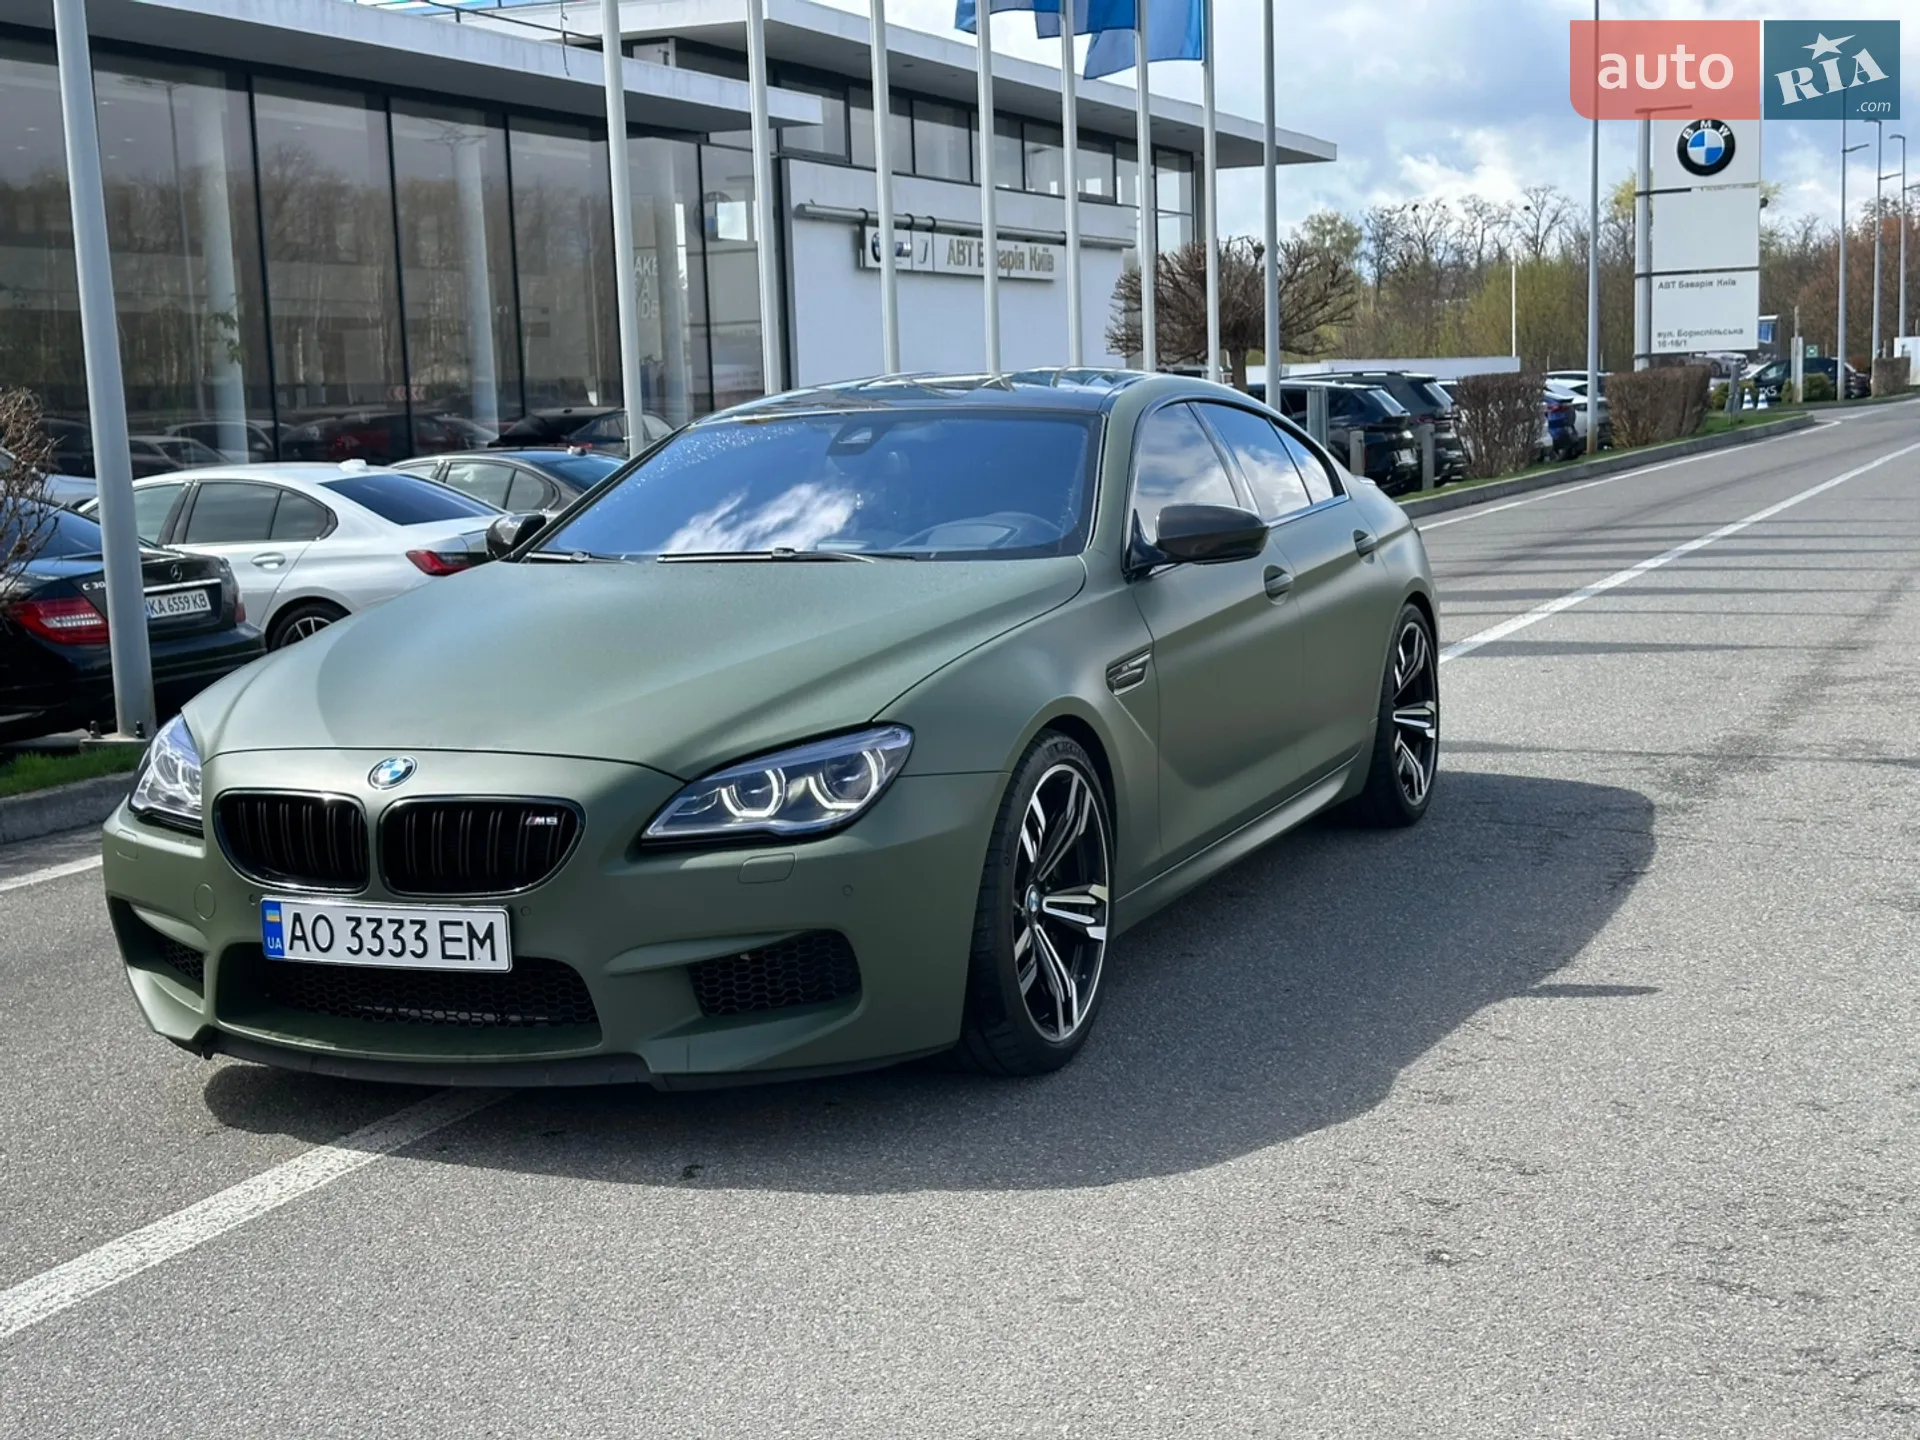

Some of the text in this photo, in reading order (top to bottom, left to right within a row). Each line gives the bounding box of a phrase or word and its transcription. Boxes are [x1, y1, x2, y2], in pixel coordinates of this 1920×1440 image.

[1682, 119, 1730, 140] BMW
[634, 256, 659, 276] AKE
[977, 240, 1025, 278] Барія
[92, 581, 106, 589] 30
[148, 593, 208, 616] KA 6559 KB
[267, 936, 283, 950] UA
[288, 912, 497, 961] AO 3333 EM
